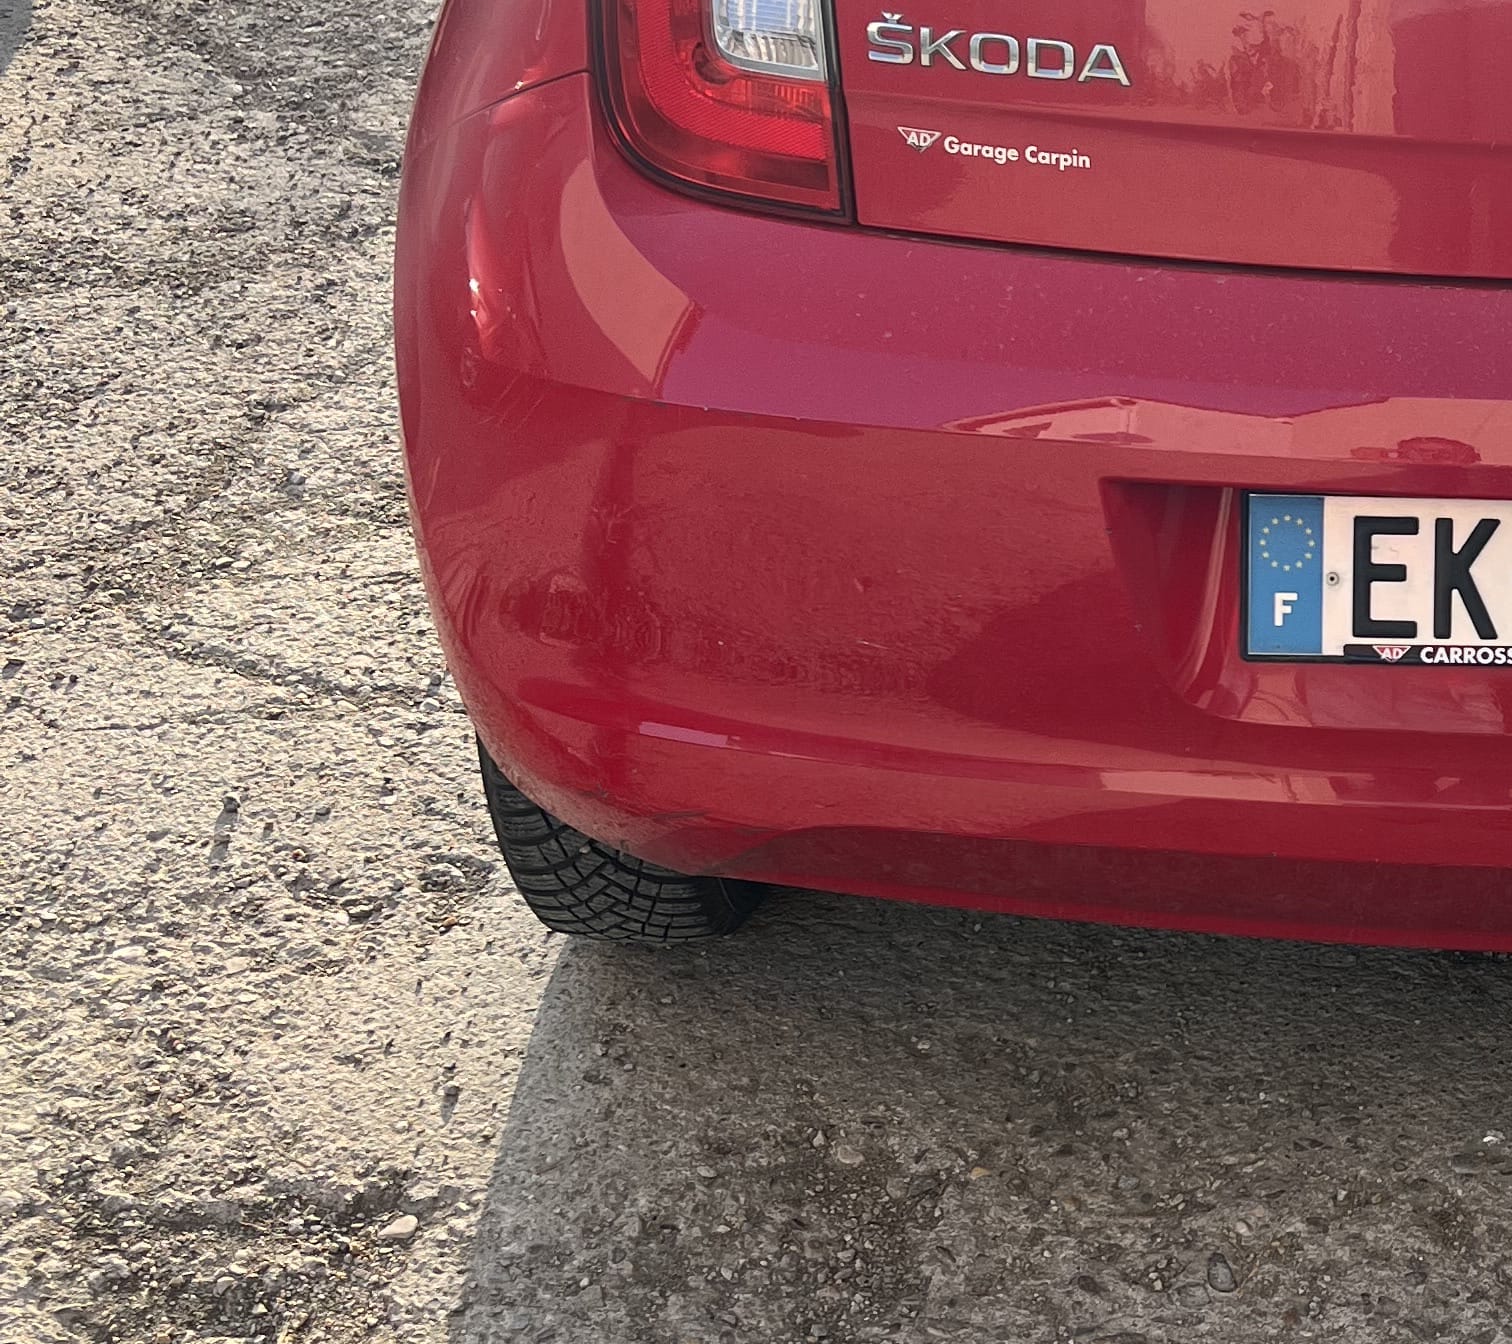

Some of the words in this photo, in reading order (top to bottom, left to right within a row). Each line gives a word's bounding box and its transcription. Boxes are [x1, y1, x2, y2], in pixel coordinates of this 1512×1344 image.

[866, 11, 1131, 86] ŠKODA
[943, 136, 1019, 164] Garage
[1025, 146, 1091, 171] Carpin
[1273, 592, 1298, 627] F
